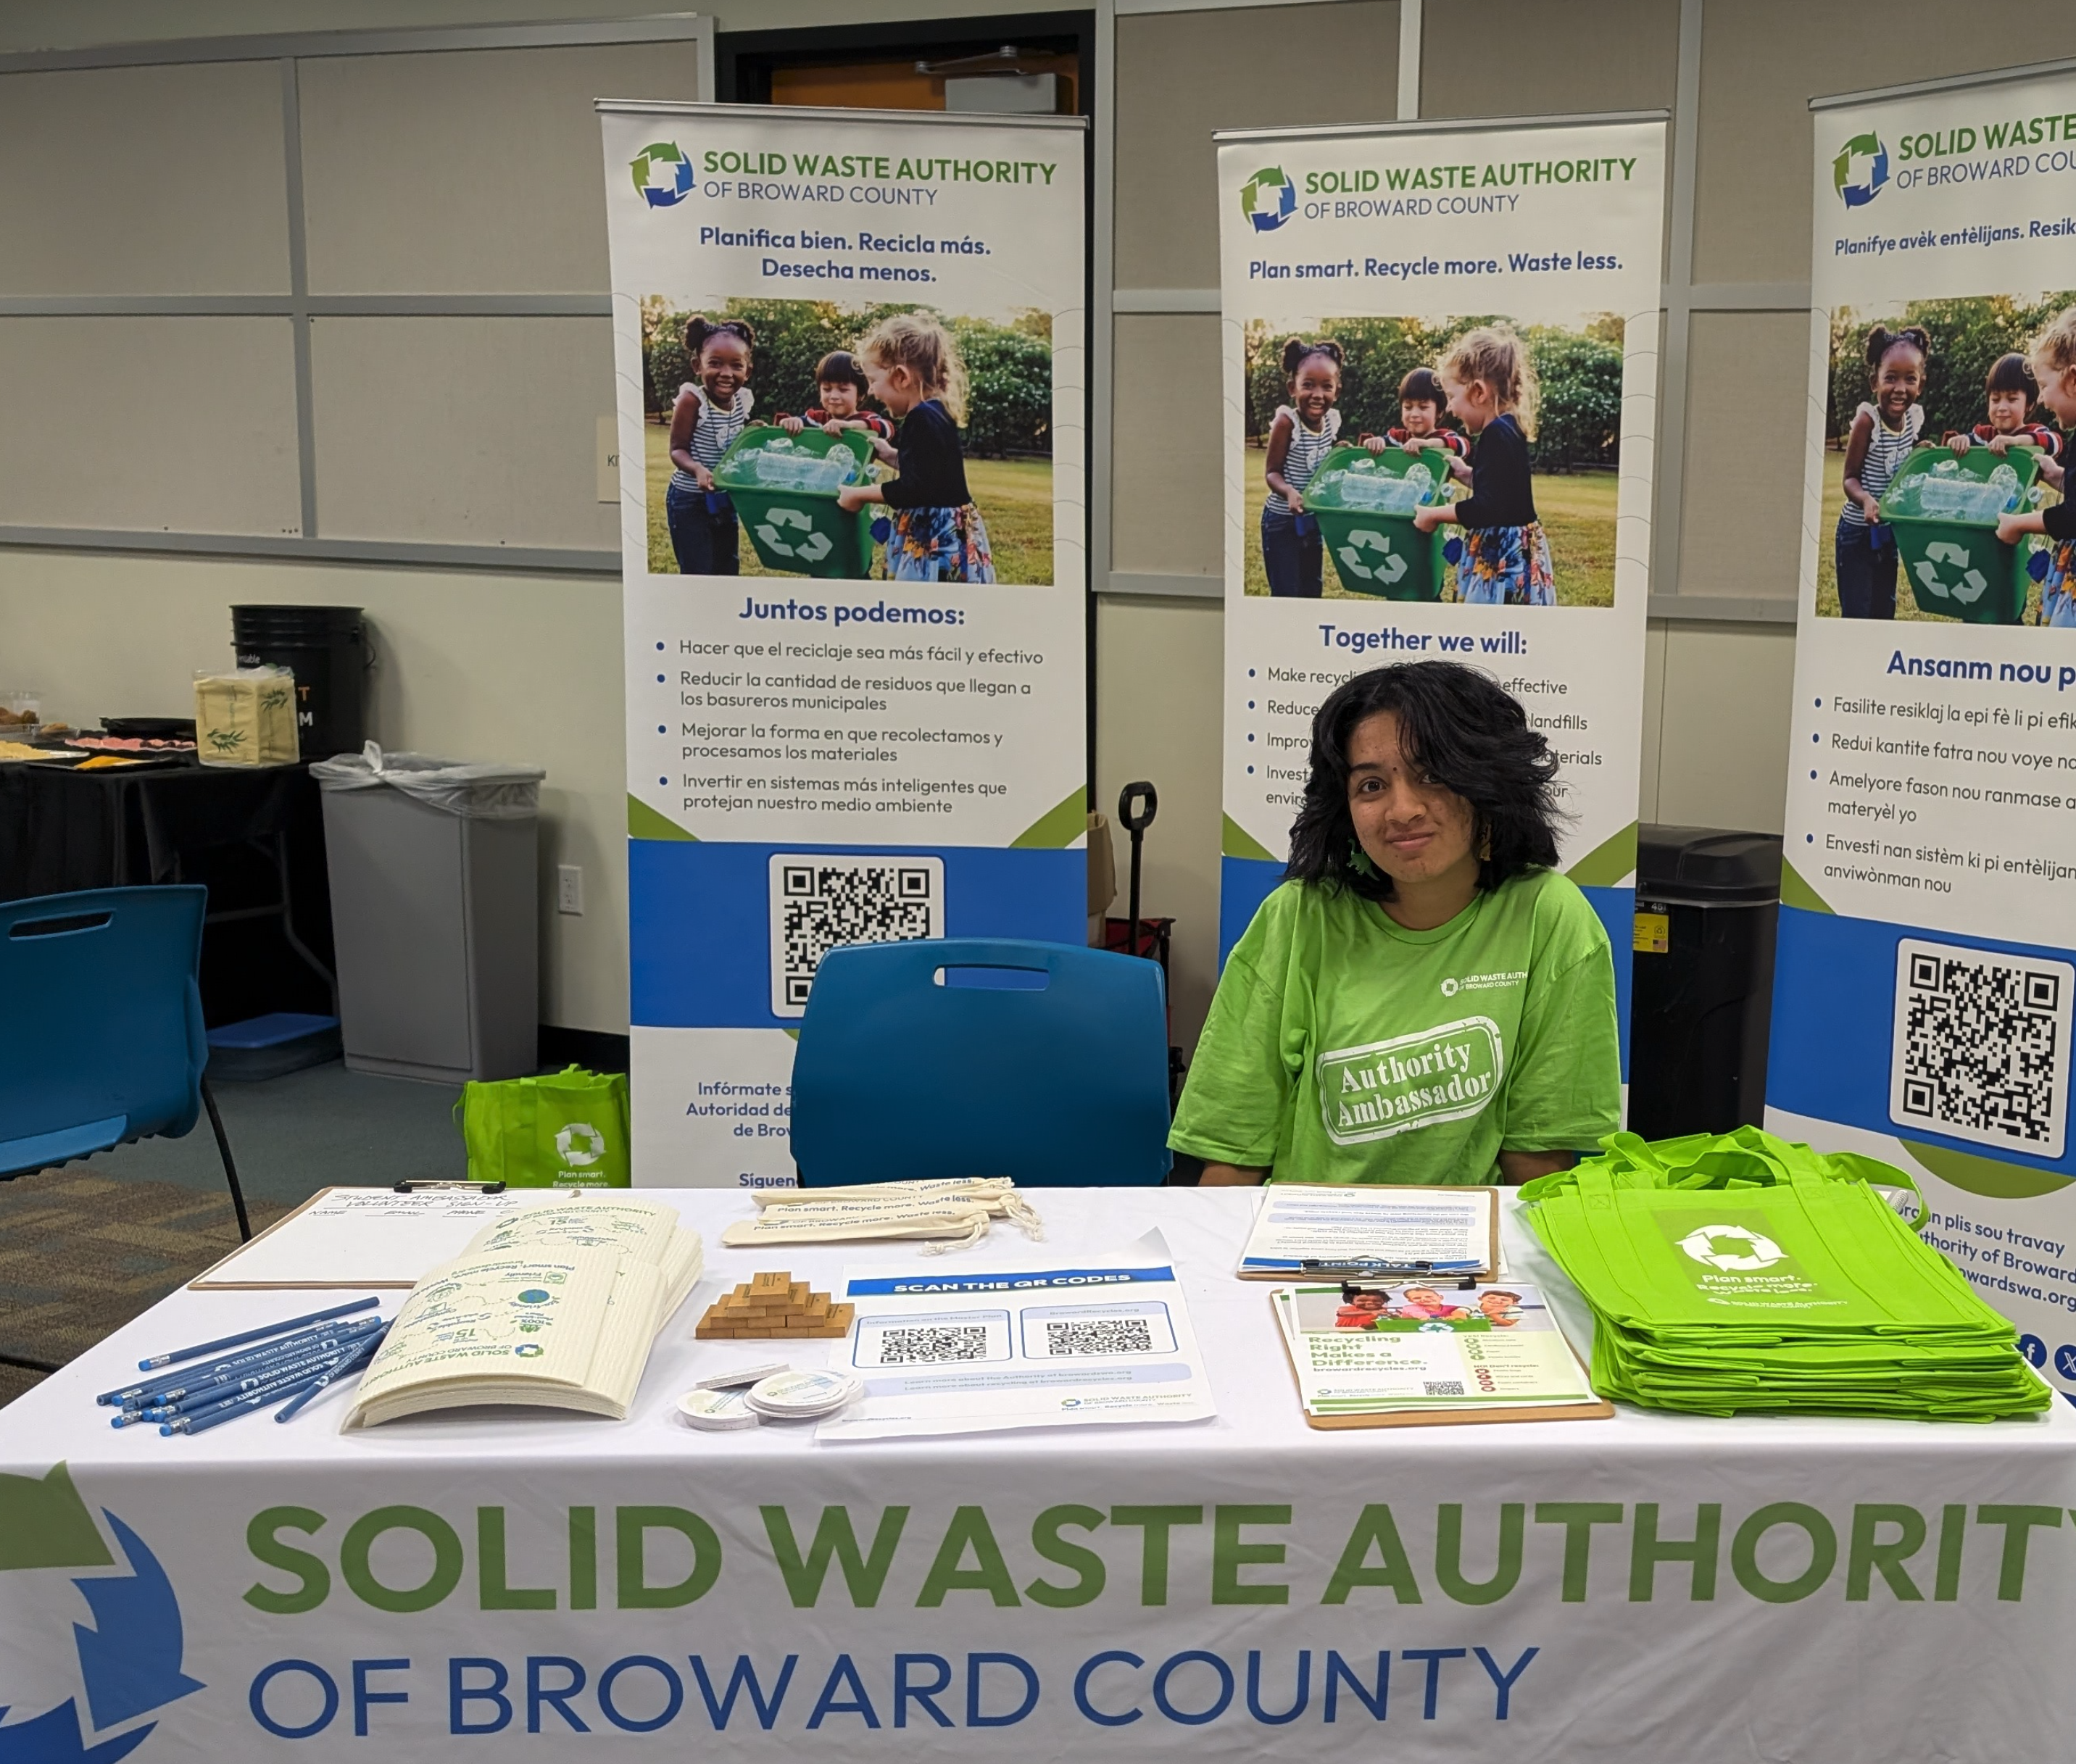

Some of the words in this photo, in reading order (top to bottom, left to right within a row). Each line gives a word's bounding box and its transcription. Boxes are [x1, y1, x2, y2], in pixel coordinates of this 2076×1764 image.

[1898, 128, 1977, 161] SOLID
[1982, 113, 2076, 150] WASTE
[703, 151, 787, 175] SOLID
[792, 154, 890, 179] WASTE
[895, 157, 1058, 186] AUTHORITY
[1305, 170, 1379, 194] SOLID
[1385, 165, 1476, 191] WASTE
[1480, 157, 1637, 188] AUTHORITY
[1896, 168, 1924, 189] OF
[1927, 156, 2030, 186] BROWARD
[704, 180, 733, 198] OF
[738, 182, 844, 202] BROWARD
[850, 186, 938, 206] COUNTY
[1304, 201, 1331, 220] OF
[1334, 198, 1432, 219] BROWARD
[1437, 194, 1519, 215] COUNTY
[700, 226, 795, 249] Planifica
[800, 230, 853, 250] bien.
[859, 232, 935, 254] Recicla
[940, 235, 991, 255] más.
[1835, 235, 1896, 256] Planifye
[1899, 230, 1937, 250] avèk
[1940, 225, 2025, 247] entèlijans.
[762, 258, 854, 279] Desecha
[859, 267, 937, 283] menos.
[1250, 260, 1291, 280] Plan
[1295, 259, 1359, 278] smart.
[1364, 256, 1440, 280] Recycle
[1444, 260, 1503, 275] more.
[1508, 252, 1572, 272] Waste
[1577, 250, 1623, 270] less.
[739, 596, 828, 621] Juntos
[834, 600, 965, 627] podemos:
[680, 639, 730, 655] Hacer
[734, 644, 765, 659] que
[768, 641, 781, 657] el
[786, 643, 853, 662] reciclaje
[856, 648, 885, 660] sea
[889, 645, 923, 660] más
[926, 646, 961, 662] fácil
[965, 651, 975, 665] y
[978, 648, 1044, 665] efectivo
[1319, 625, 1433, 654] Together
[1437, 636, 1474, 652] we
[1479, 631, 1527, 654] will:
[1268, 667, 1306, 683] Make
[1886, 650, 1993, 681] Ansanm
[1999, 663, 2051, 684] nou
[1502, 678, 1568, 694] effective
[1267, 701, 1319, 717] Reduce
[1530, 713, 1587, 731] landfills
[1834, 696, 1886, 715] Fasilite
[1890, 702, 1944, 724] resiklaj
[1947, 704, 1961, 721] la
[1964, 707, 1989, 727] epi
[1992, 707, 2010, 725] fè
[2014, 709, 2023, 726] li
[2027, 711, 2043, 731] pi
[1542, 750, 1602, 766] aterials
[683, 773, 743, 789] Invertir
[747, 778, 766, 789] en
[771, 775, 840, 791] sistemas
[844, 777, 878, 792] más
[881, 778, 975, 796] inteligentes
[978, 783, 1007, 798] que
[1266, 765, 1308, 781] Invest
[1829, 770, 1903, 793] Amelyore
[1905, 777, 1948, 797] fason
[1952, 786, 1981, 801] nou
[1985, 790, 2062, 808] ranmase
[1828, 800, 1896, 822] materyèl
[1898, 809, 1917, 825] yo
[1826, 833, 1880, 855] Envesti
[1883, 844, 1912, 860] nan
[1915, 846, 1964, 867] sistèm
[1967, 851, 1980, 868] ki
[1984, 854, 2000, 873] pi
[1824, 865, 1920, 889] anviwònman
[1924, 878, 1952, 894] nou
[1480, 973, 1506, 981] WASTE
[1342, 1041, 1471, 1093] Authority
[698, 1081, 782, 1096] Infórmate
[1338, 1070, 1491, 1127] Ambassador
[686, 1102, 769, 1116] Autoridad
[733, 1123, 754, 1137] de
[739, 1173, 798, 1188] Síguen
[1944, 1214, 1972, 1233] plis
[1975, 1224, 2003, 1241] sou
[2006, 1228, 2065, 1259] travay
[1919, 1232, 1977, 1262] thority
[1981, 1248, 2001, 1265] of
[2003, 1251, 2076, 1284] Broward
[894, 1283, 959, 1294] SCAN
[967, 1281, 1010, 1290] THE
[1013, 1279, 1047, 1289] QR
[1052, 1273, 1132, 1286] CODES
[260, 1368, 280, 1381] SOLID
[280, 1361, 306, 1373] WASTE
[306, 1347, 345, 1368] AUTHORITY
[241, 1505, 723, 1615] SOLID
[757, 1503, 1292, 1609] WASTE
[1320, 1500, 2076, 1606] AUTHORIT
[249, 1658, 410, 1739] OF
[449, 1652, 1039, 1736] BROWARD
[1074, 1647, 1540, 1726] COUNTY
